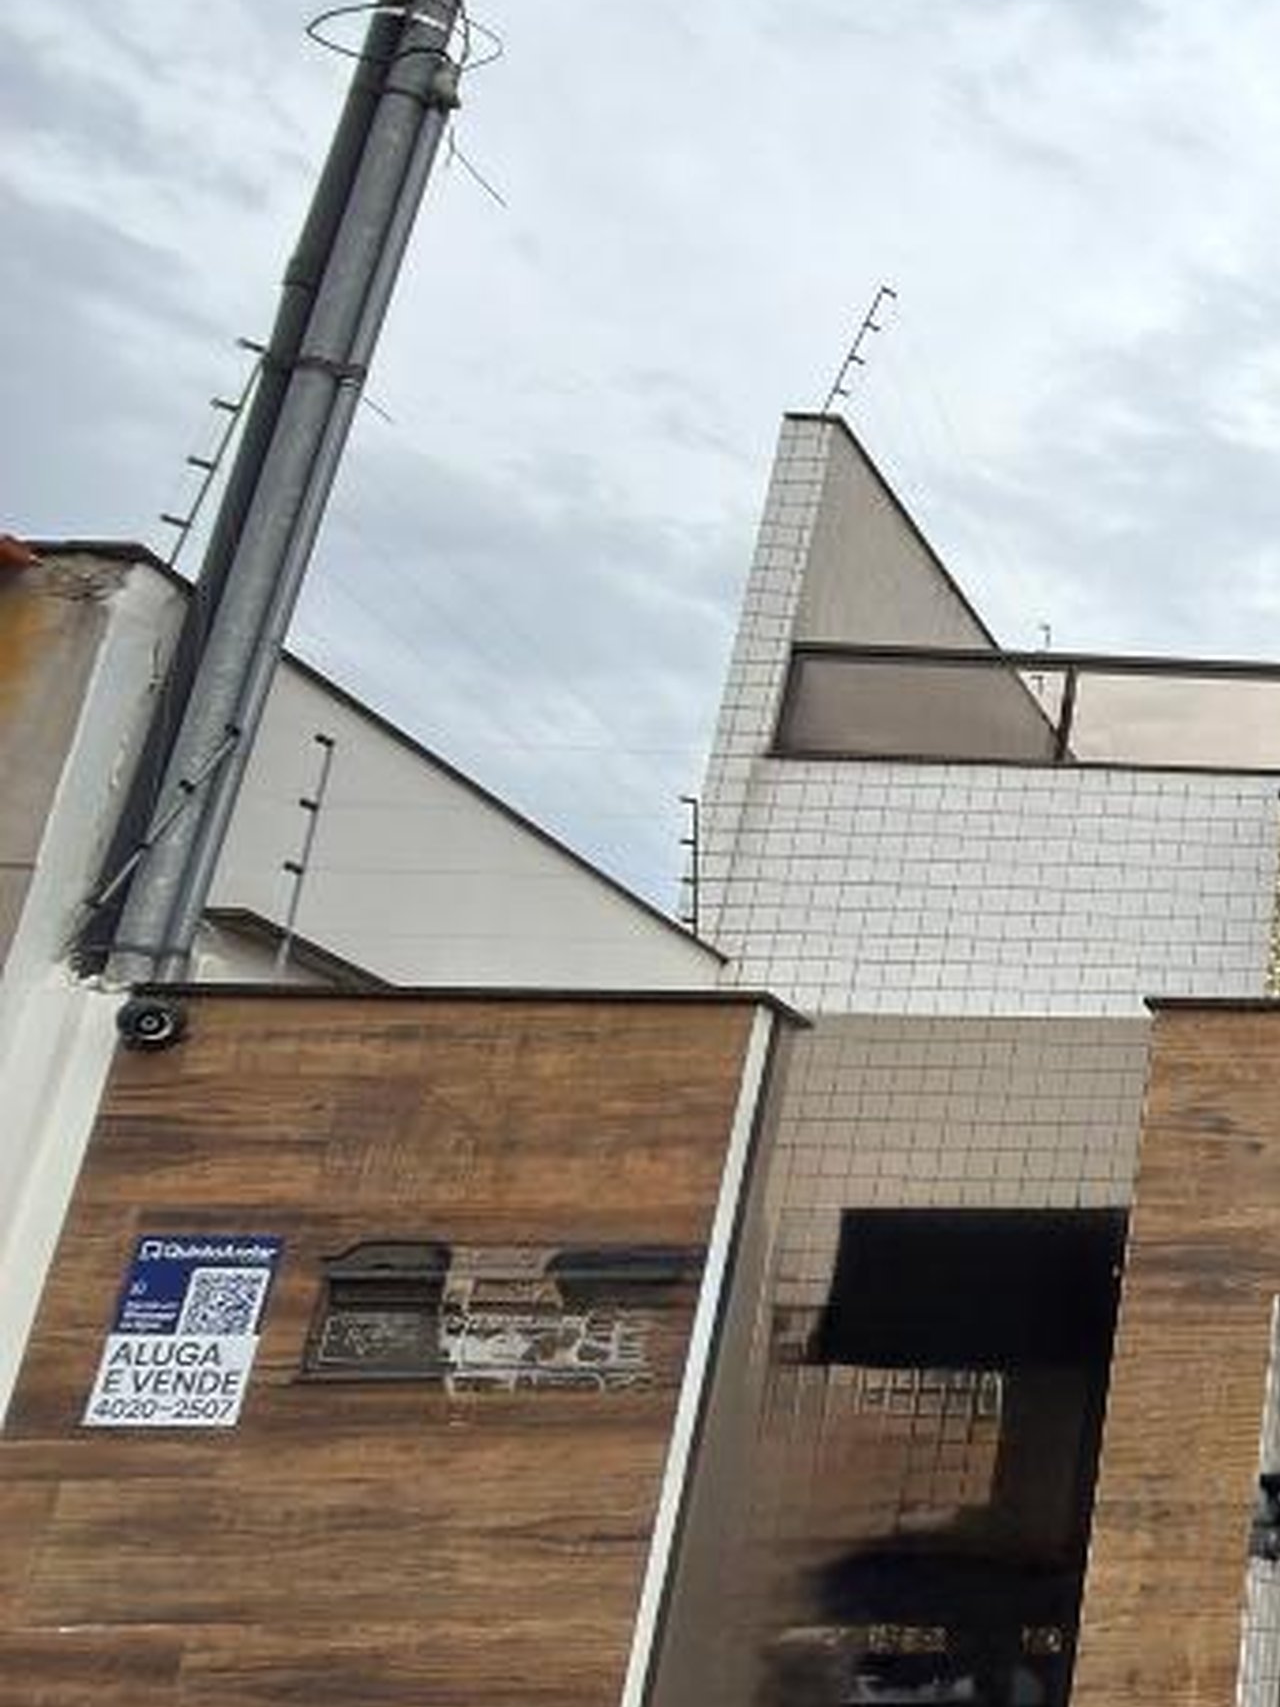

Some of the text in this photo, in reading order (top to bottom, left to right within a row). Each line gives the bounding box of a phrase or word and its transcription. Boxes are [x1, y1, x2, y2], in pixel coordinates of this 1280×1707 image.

[109, 1342, 222, 1366] ALUGA
[102, 1368, 241, 1395] E VENDE
[93, 1398, 236, 1419] 4020-2507
